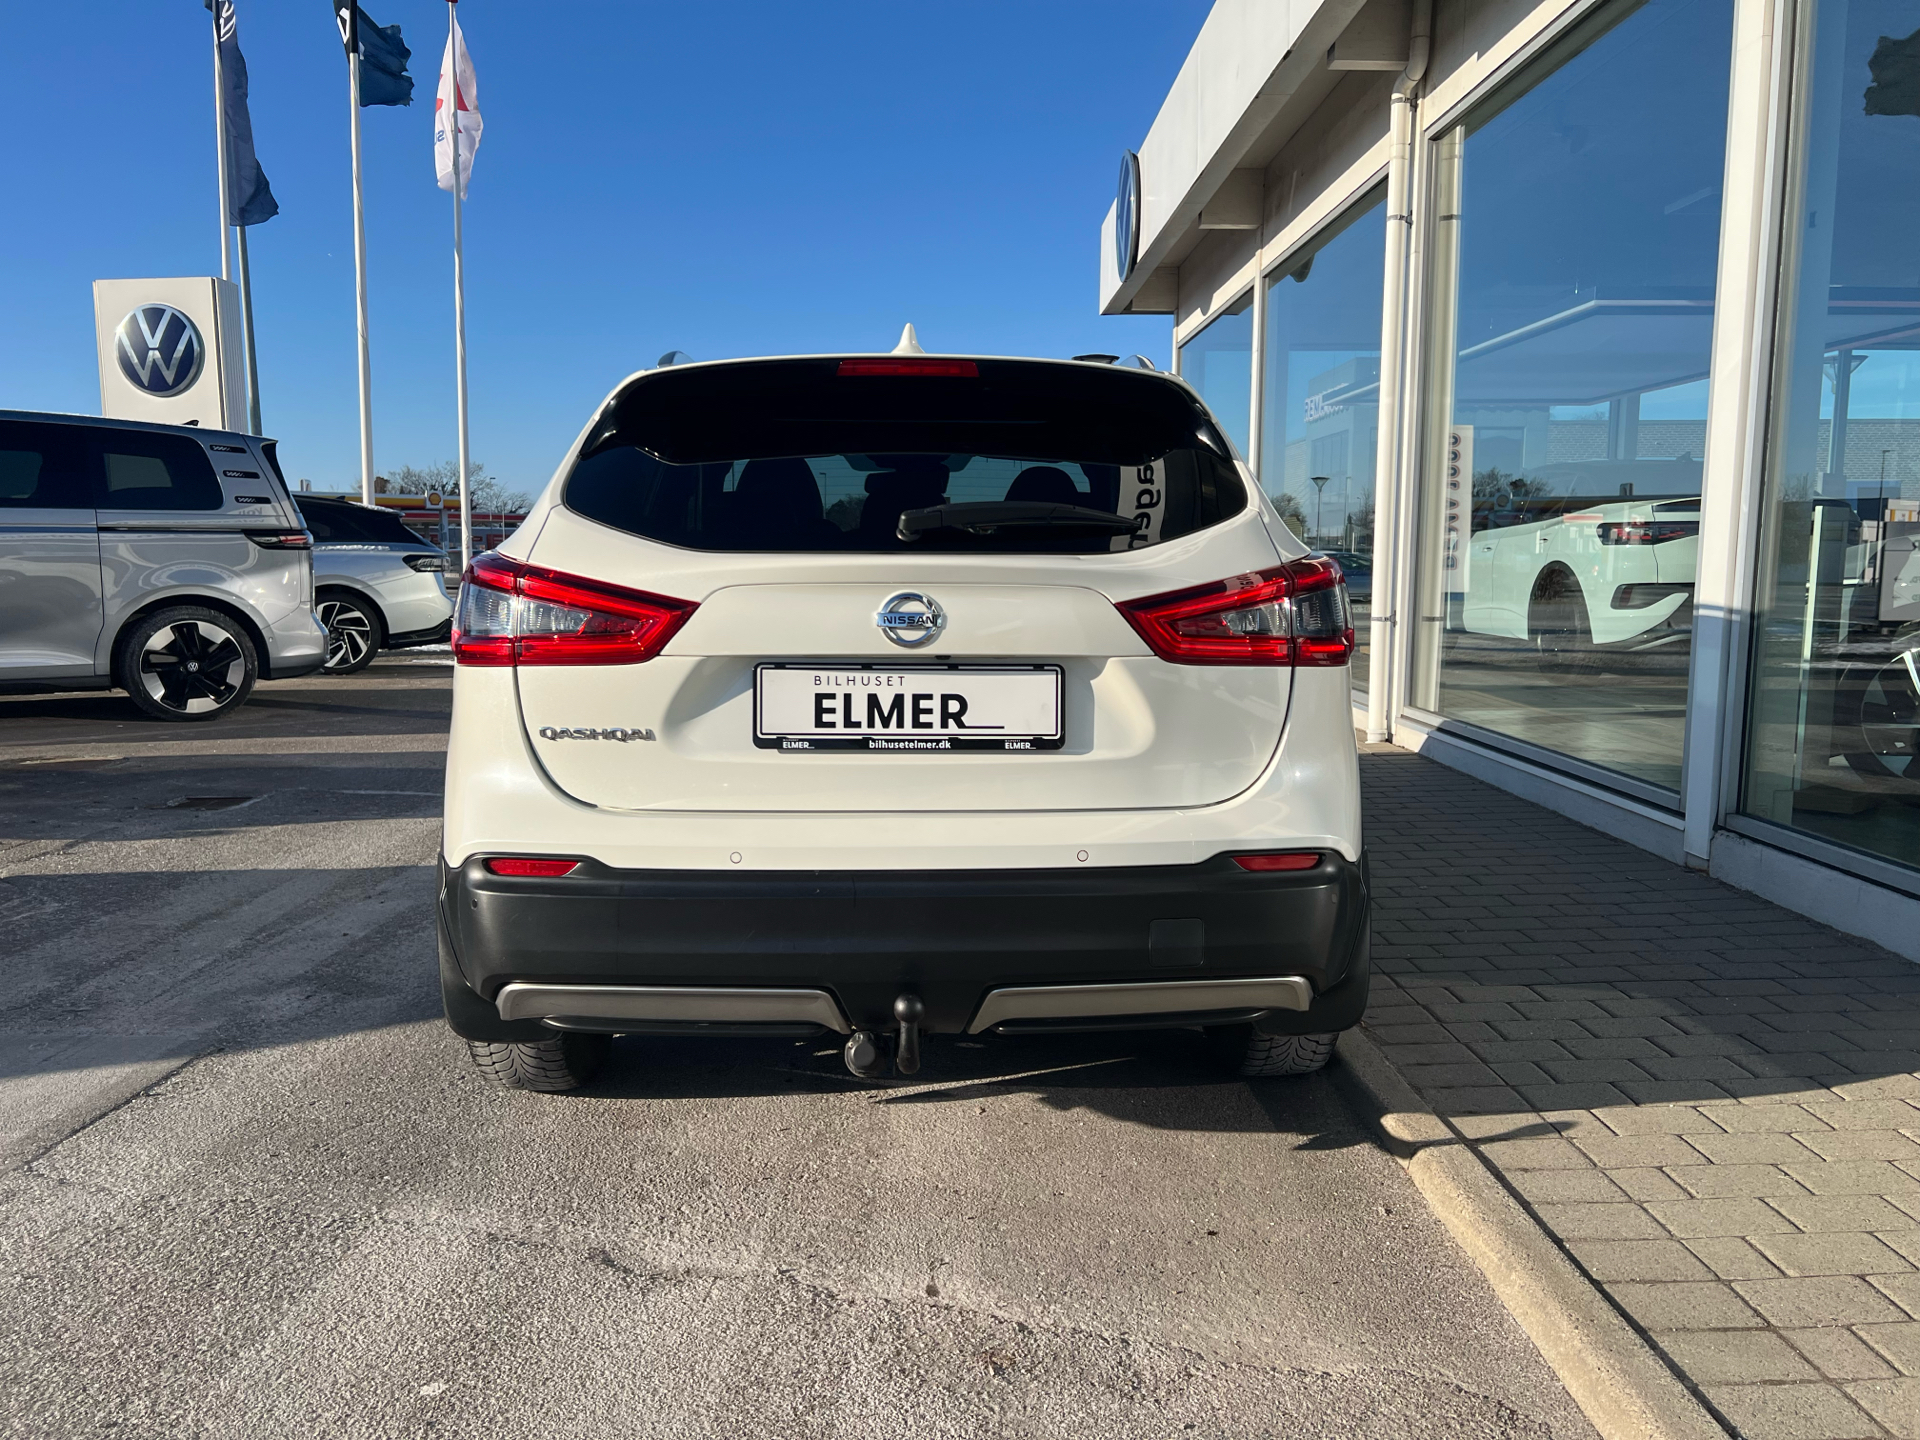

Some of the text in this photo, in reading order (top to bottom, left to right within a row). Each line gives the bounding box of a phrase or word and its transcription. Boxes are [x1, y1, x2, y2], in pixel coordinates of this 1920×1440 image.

[883, 615, 936, 625] NISSAN
[814, 675, 906, 686] BILHUSET
[814, 692, 1004, 729] ELMER
[539, 727, 656, 743] QASHQAI
[783, 741, 814, 749] ELMER
[869, 740, 951, 749] bilhusetelmer.dk
[1005, 742, 1036, 750] ELMER
